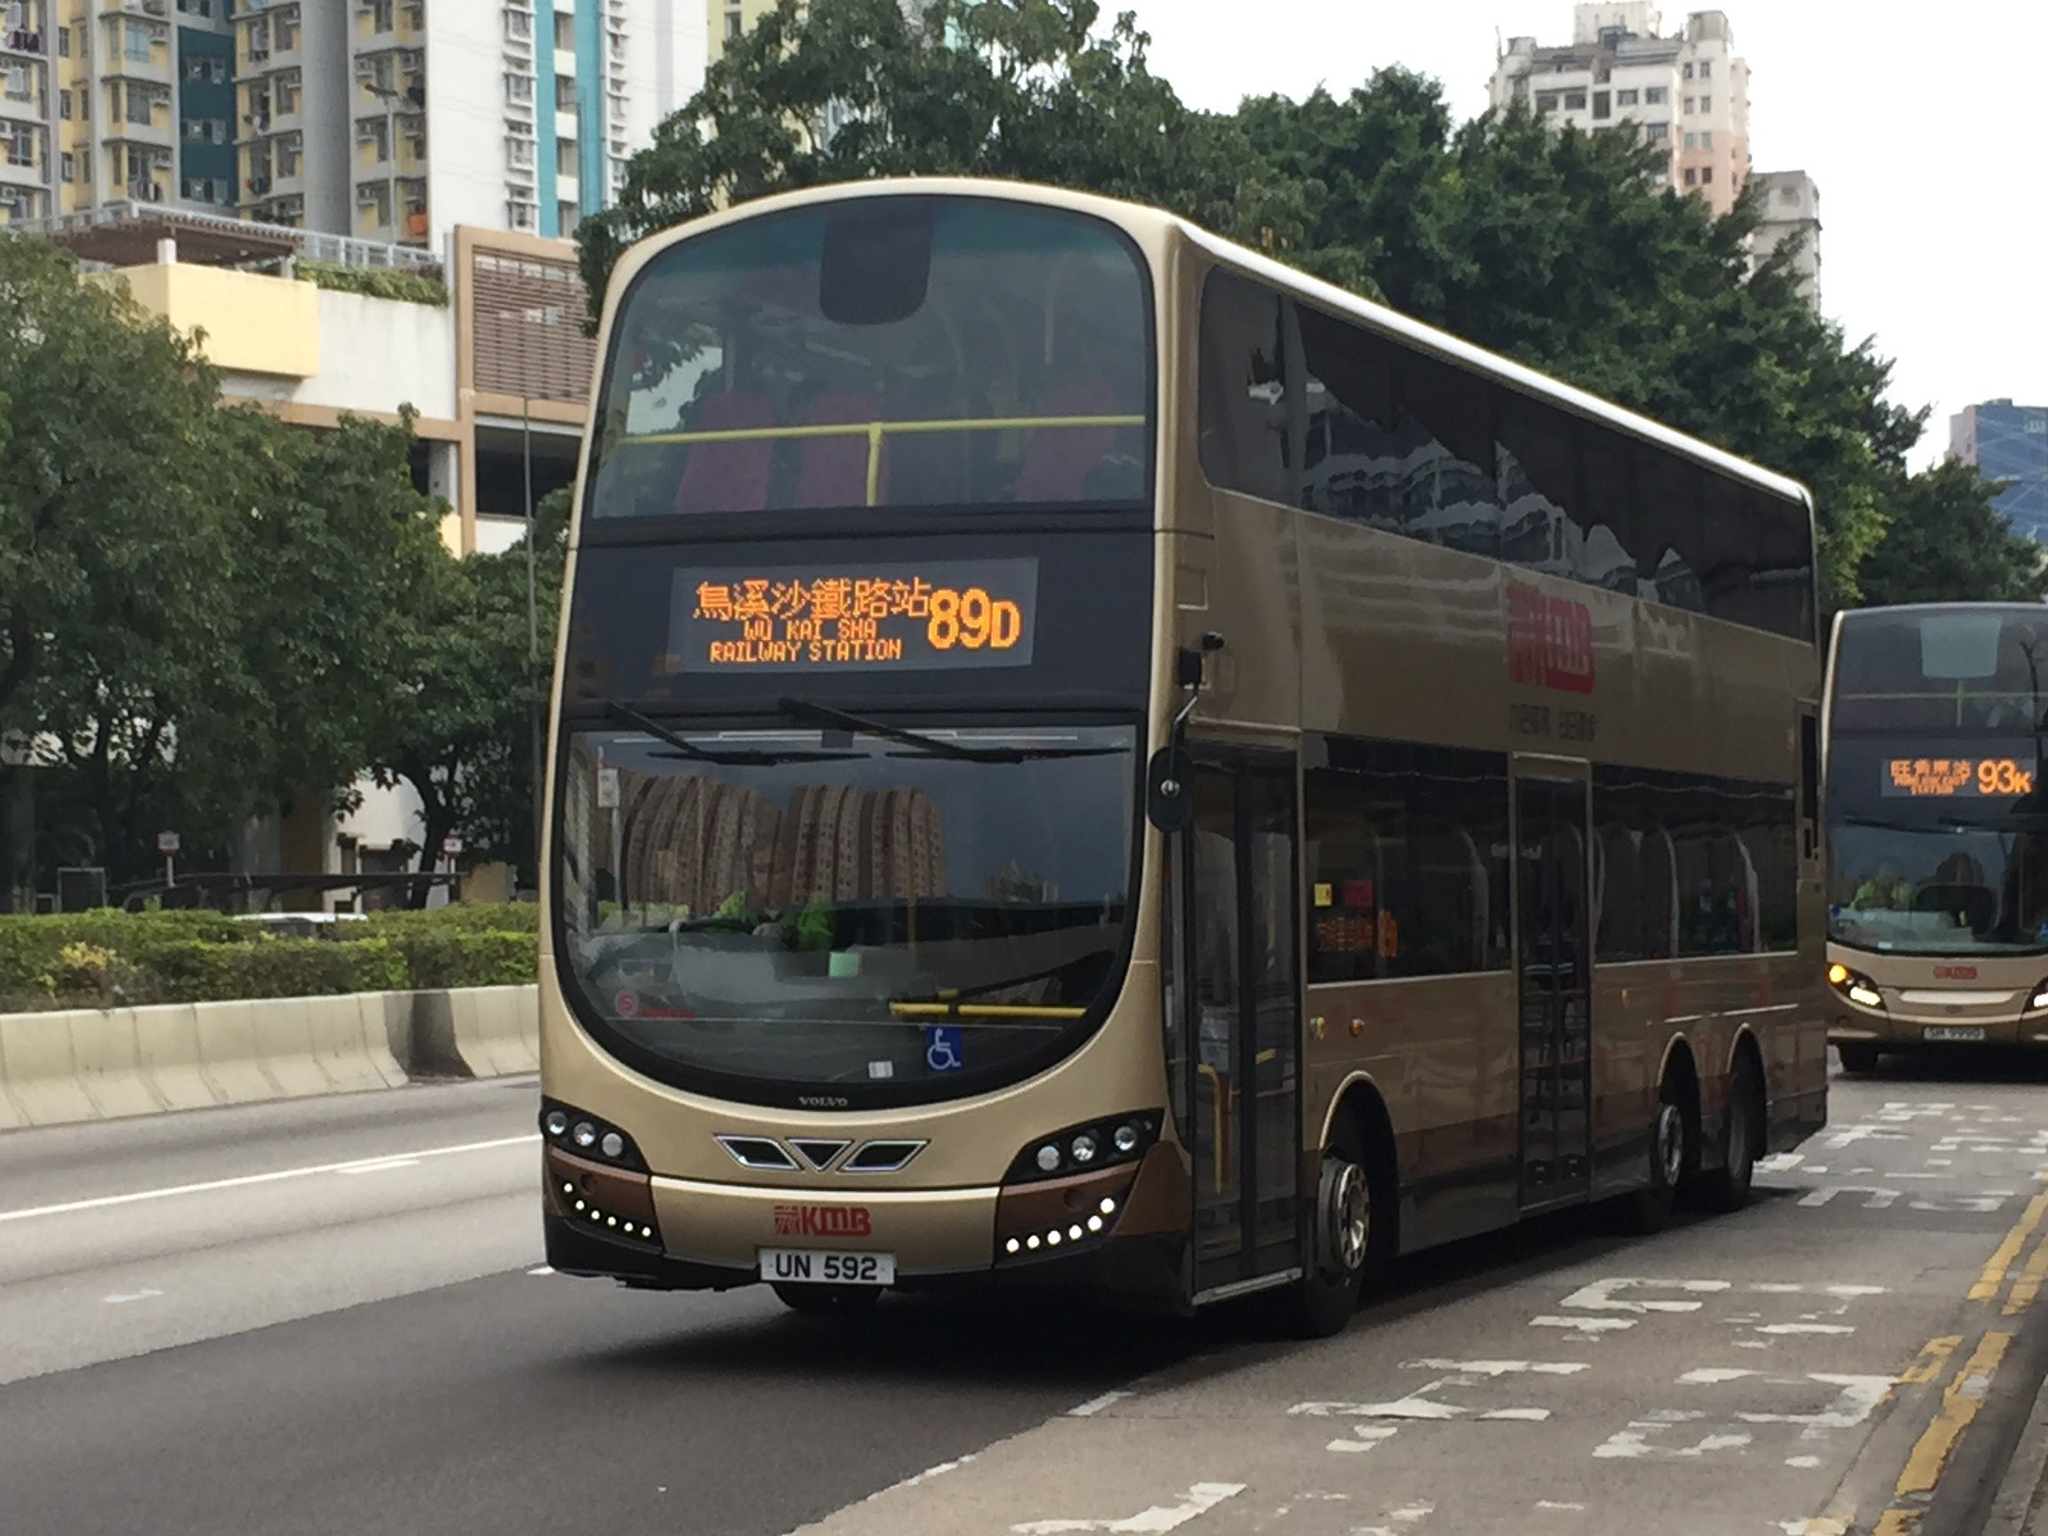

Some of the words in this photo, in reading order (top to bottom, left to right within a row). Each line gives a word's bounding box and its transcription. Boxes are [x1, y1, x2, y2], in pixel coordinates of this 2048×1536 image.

[693, 577, 930, 620] 烏溪沙鐵路站
[744, 619, 772, 641] WU
[786, 618, 822, 641] KAI
[838, 618, 876, 640] SHA
[928, 588, 1020, 649] 89D
[709, 640, 799, 663] RAILWAY
[808, 639, 901, 662] STATION
[1977, 758, 2032, 794] 93K
[799, 1096, 848, 1106] VOLVO
[800, 1206, 872, 1237] KMB
[775, 1253, 811, 1278] UN
[823, 1256, 878, 1280] 592
